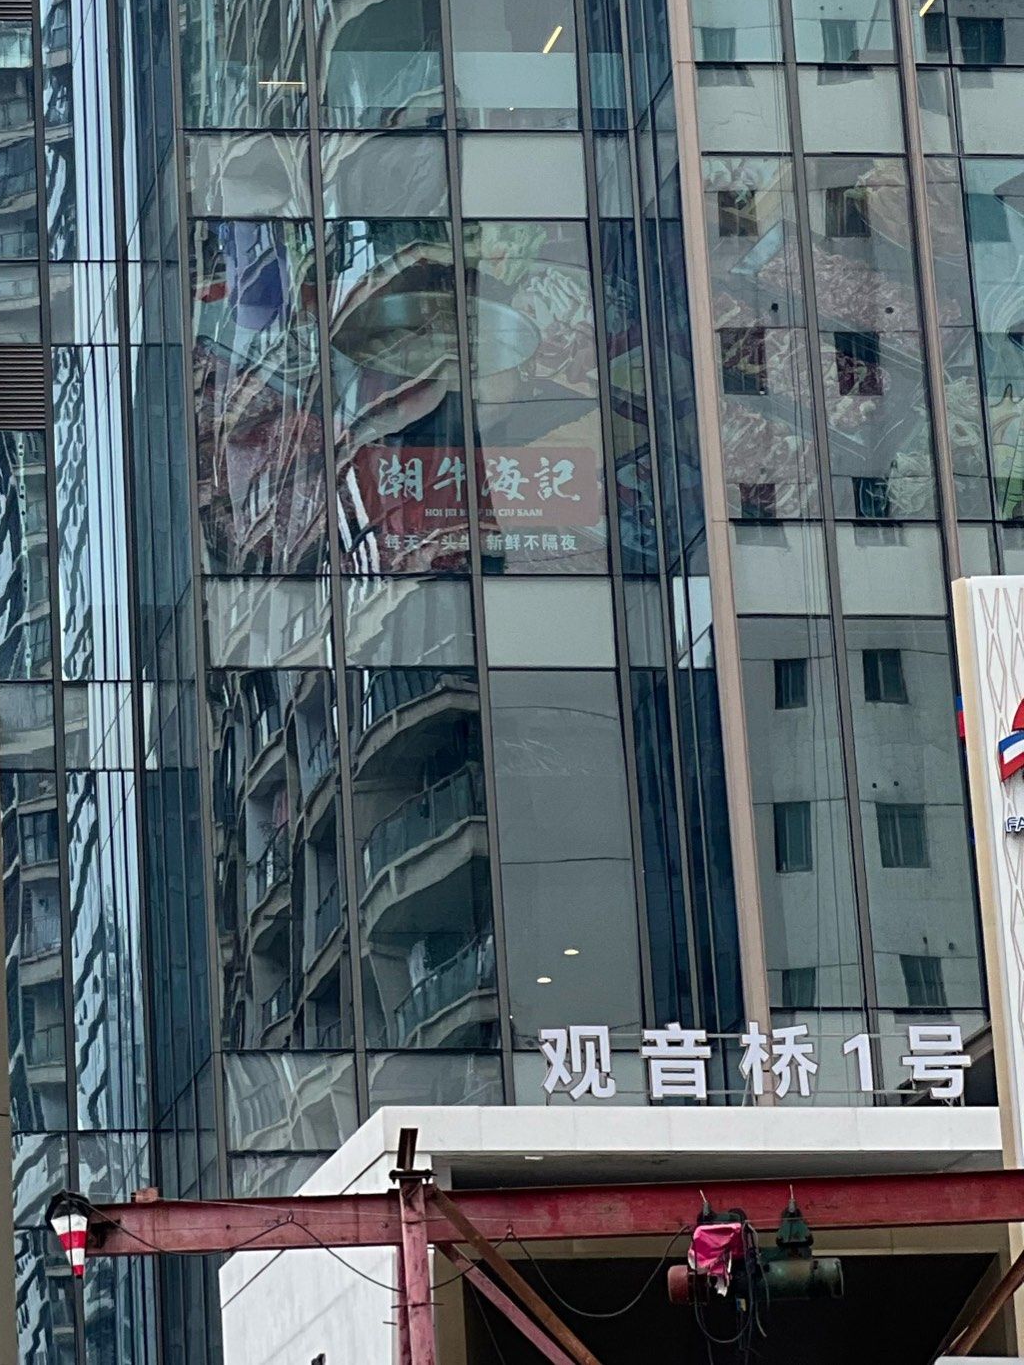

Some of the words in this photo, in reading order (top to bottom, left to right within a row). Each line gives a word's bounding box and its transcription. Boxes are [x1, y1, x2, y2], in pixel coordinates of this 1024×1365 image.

[485, 533, 578, 551] 新鲜不隔夜
[540, 1021, 972, 1099] 观音桥1号
